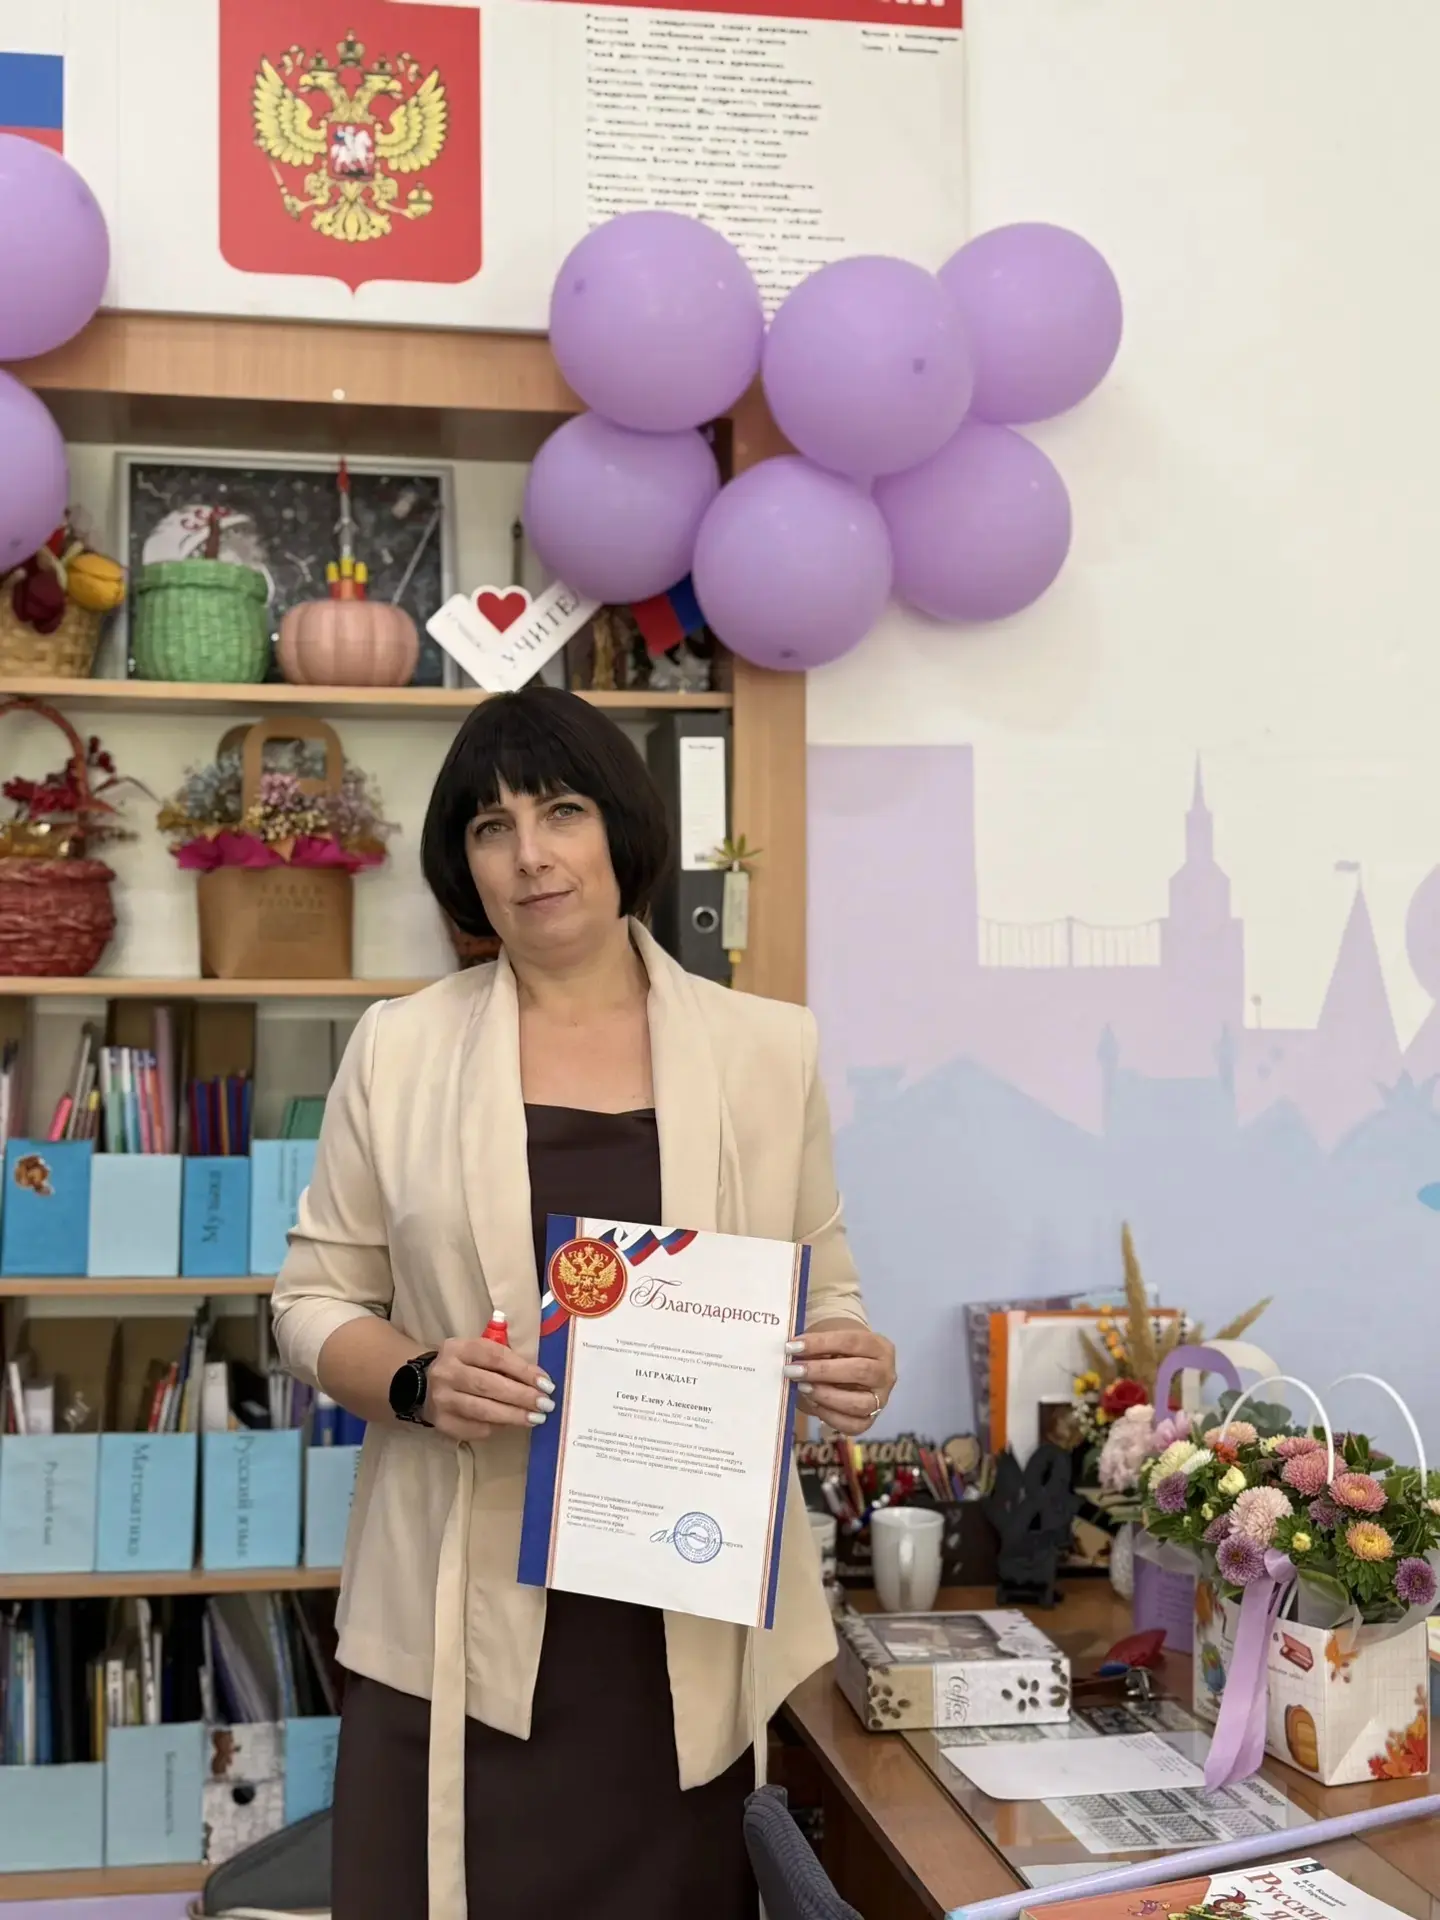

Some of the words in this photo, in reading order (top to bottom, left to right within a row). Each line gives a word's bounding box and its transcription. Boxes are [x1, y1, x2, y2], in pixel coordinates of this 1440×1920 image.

[629, 1276, 780, 1326] Благодарность
[634, 1369, 698, 1386] НАГРАЖДАЕТ
[641, 1394, 665, 1406] Елену
[666, 1398, 713, 1413] Алексеевну
